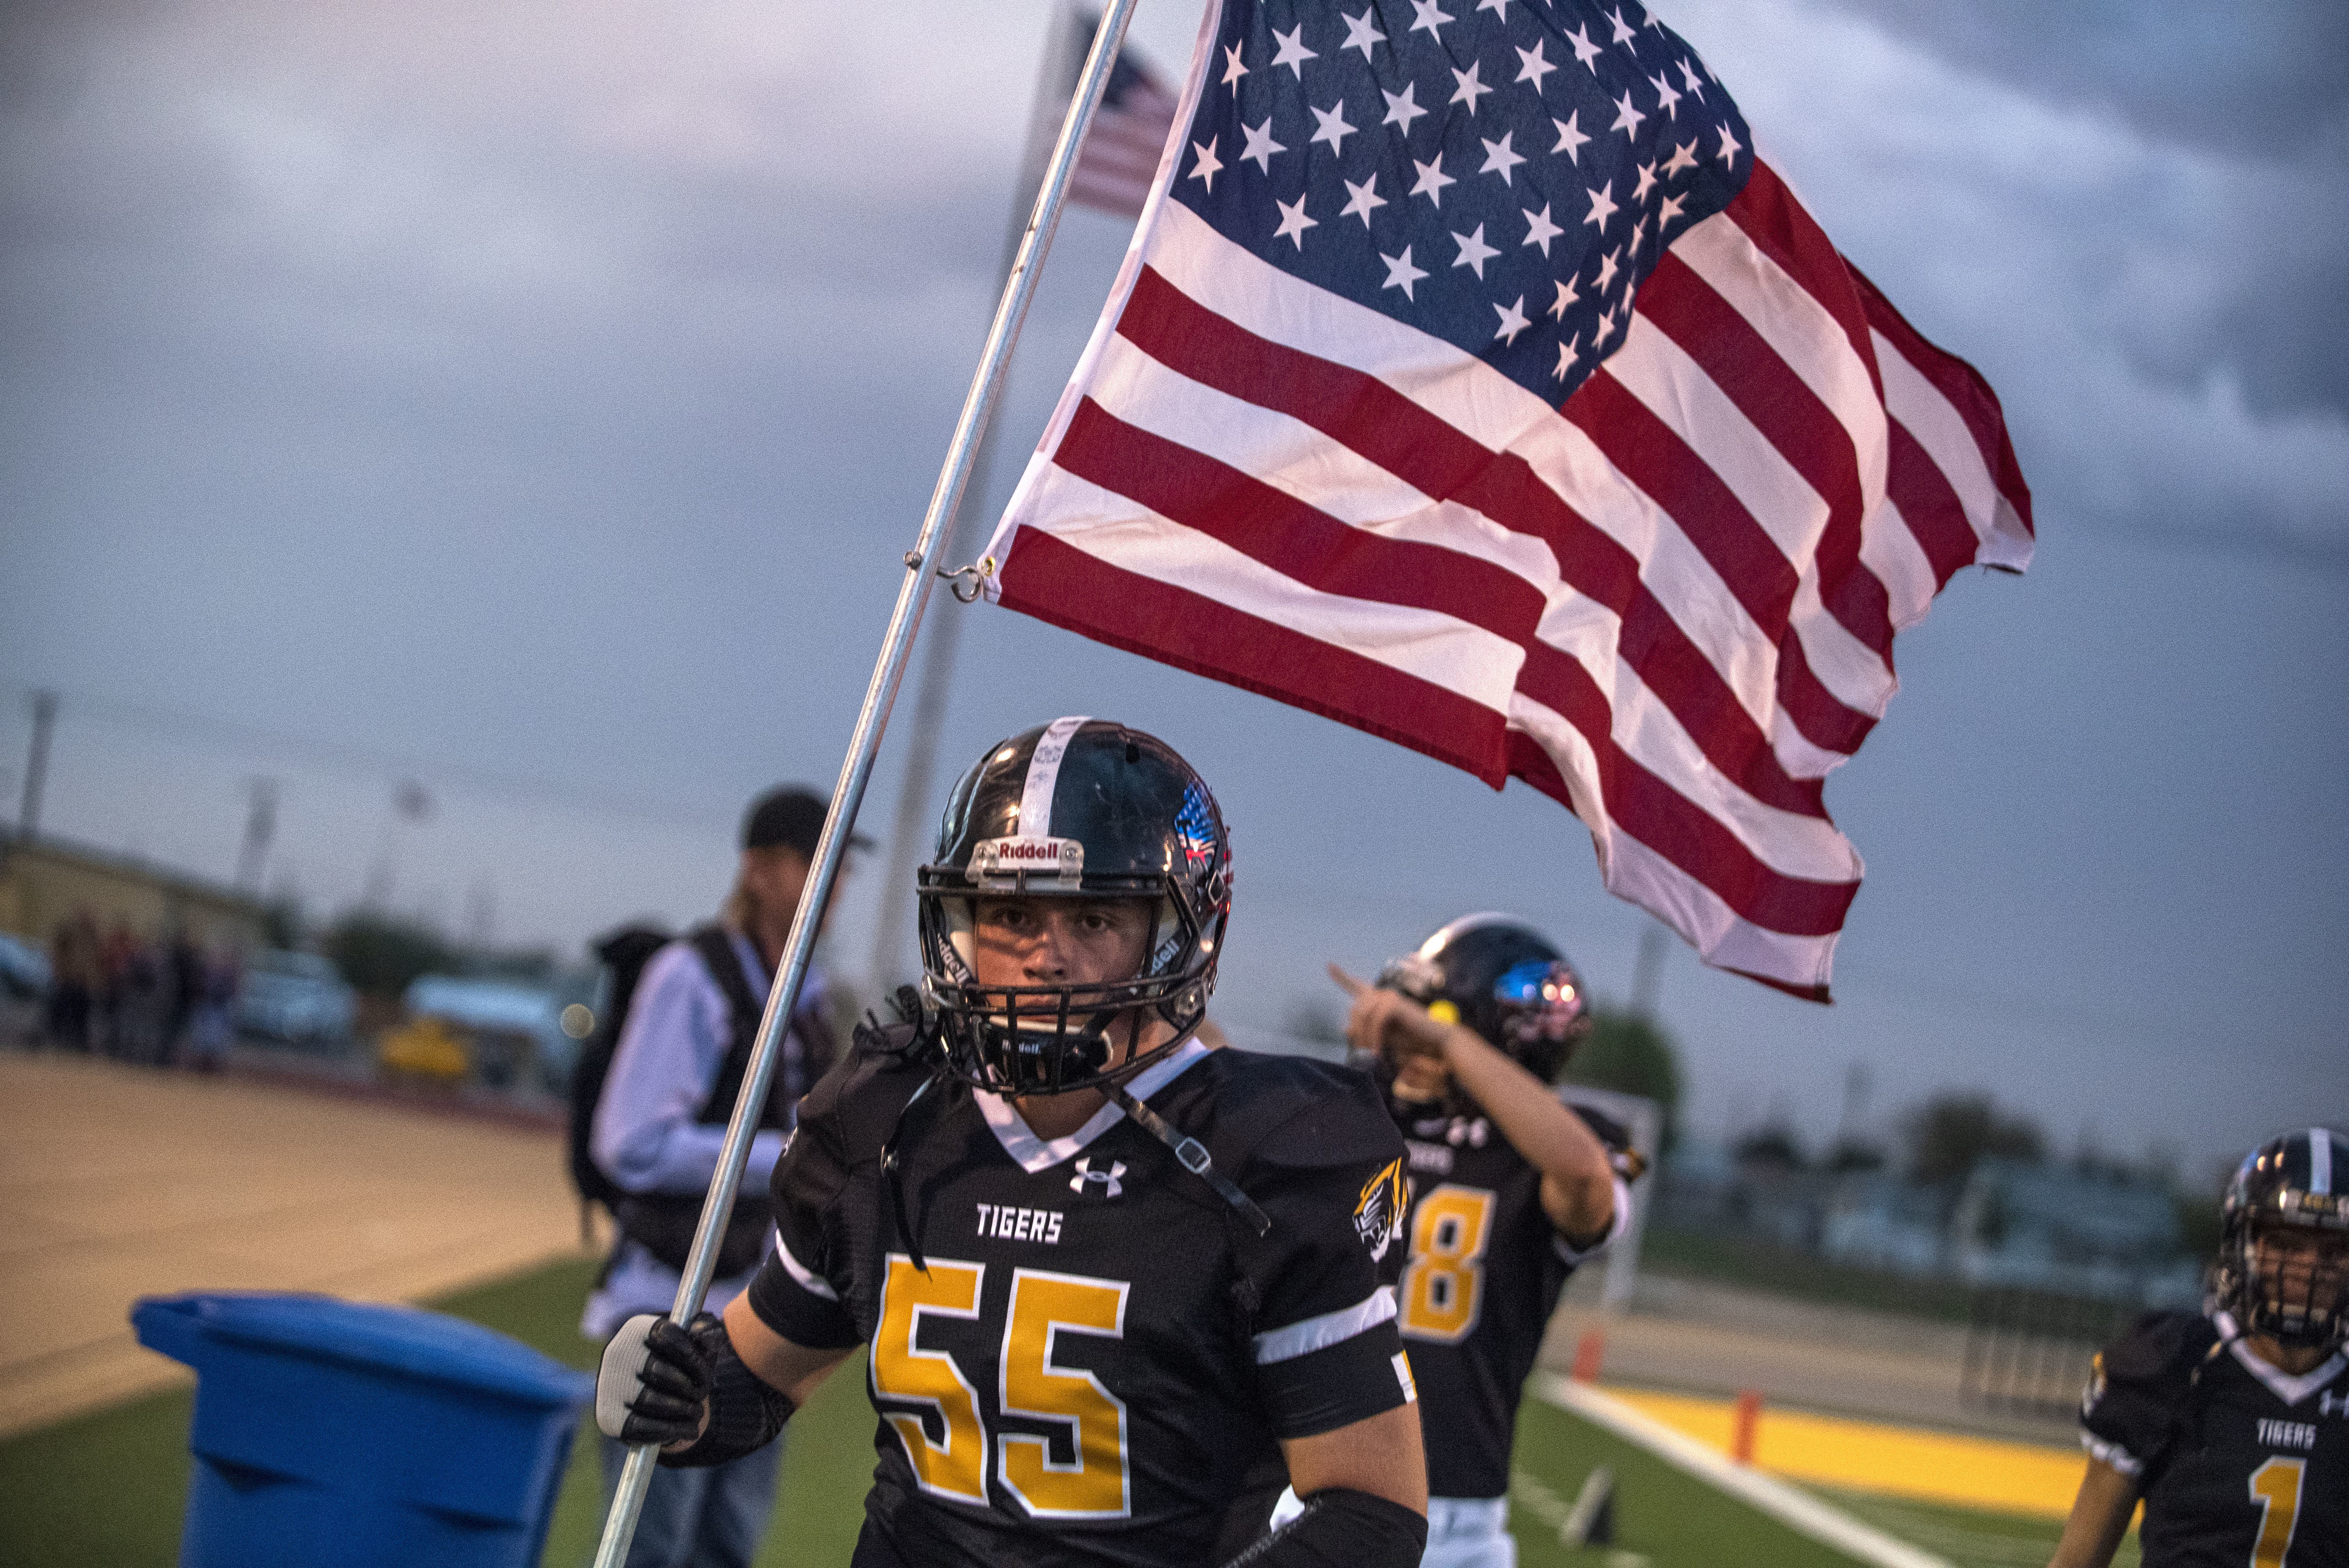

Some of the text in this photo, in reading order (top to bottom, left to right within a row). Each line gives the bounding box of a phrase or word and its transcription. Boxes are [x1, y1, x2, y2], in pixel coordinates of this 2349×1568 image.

[999, 842, 1059, 860] Riddell
[977, 1203, 1064, 1245] TIGERS
[1399, 1176, 1498, 1345] 8
[870, 1252, 1131, 1519] 55
[2248, 1454, 2307, 1568] 1
